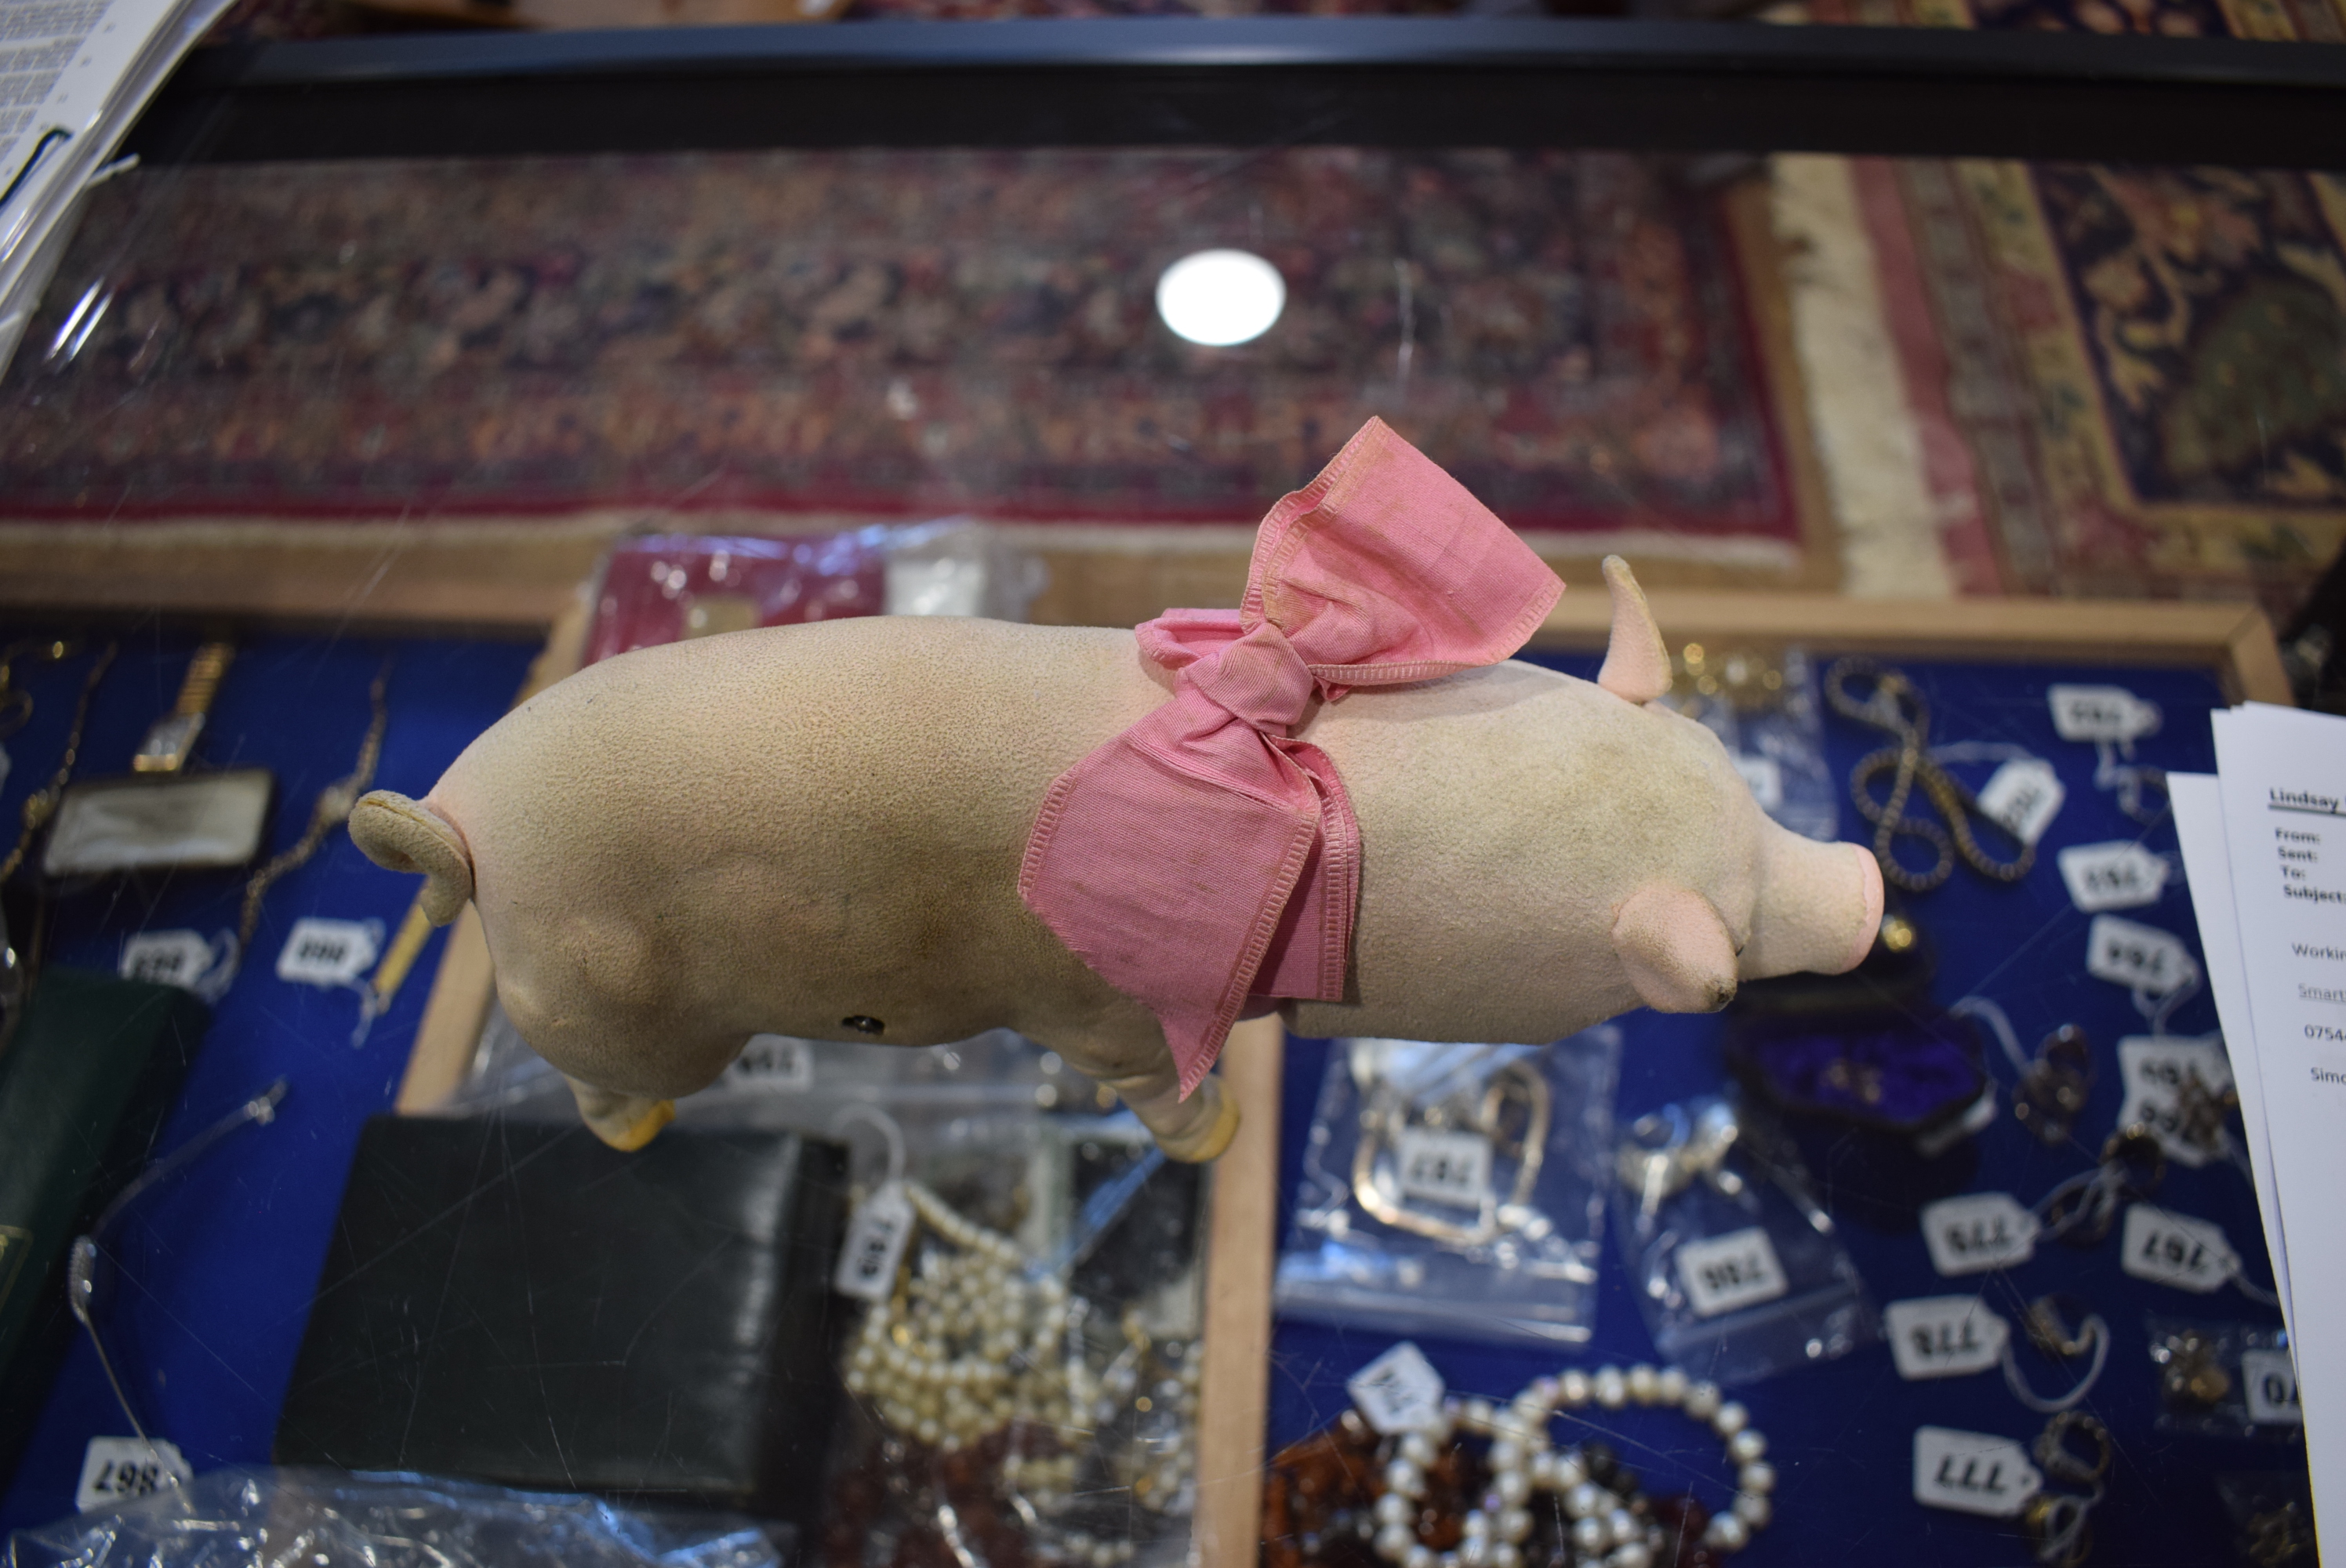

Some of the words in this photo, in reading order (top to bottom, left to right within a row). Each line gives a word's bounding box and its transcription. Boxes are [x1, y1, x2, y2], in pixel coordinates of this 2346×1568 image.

[2269, 789, 2338, 814] Lindsay
[2275, 828, 2320, 844] From:
[2278, 847, 2318, 862] Sent:
[2282, 866, 2306, 880] To:
[2304, 1024, 2346, 1042] 0754
[2141, 1229, 2207, 1273] 767
[92, 1459, 159, 1497] 867
[1934, 1454, 2009, 1496] 777
